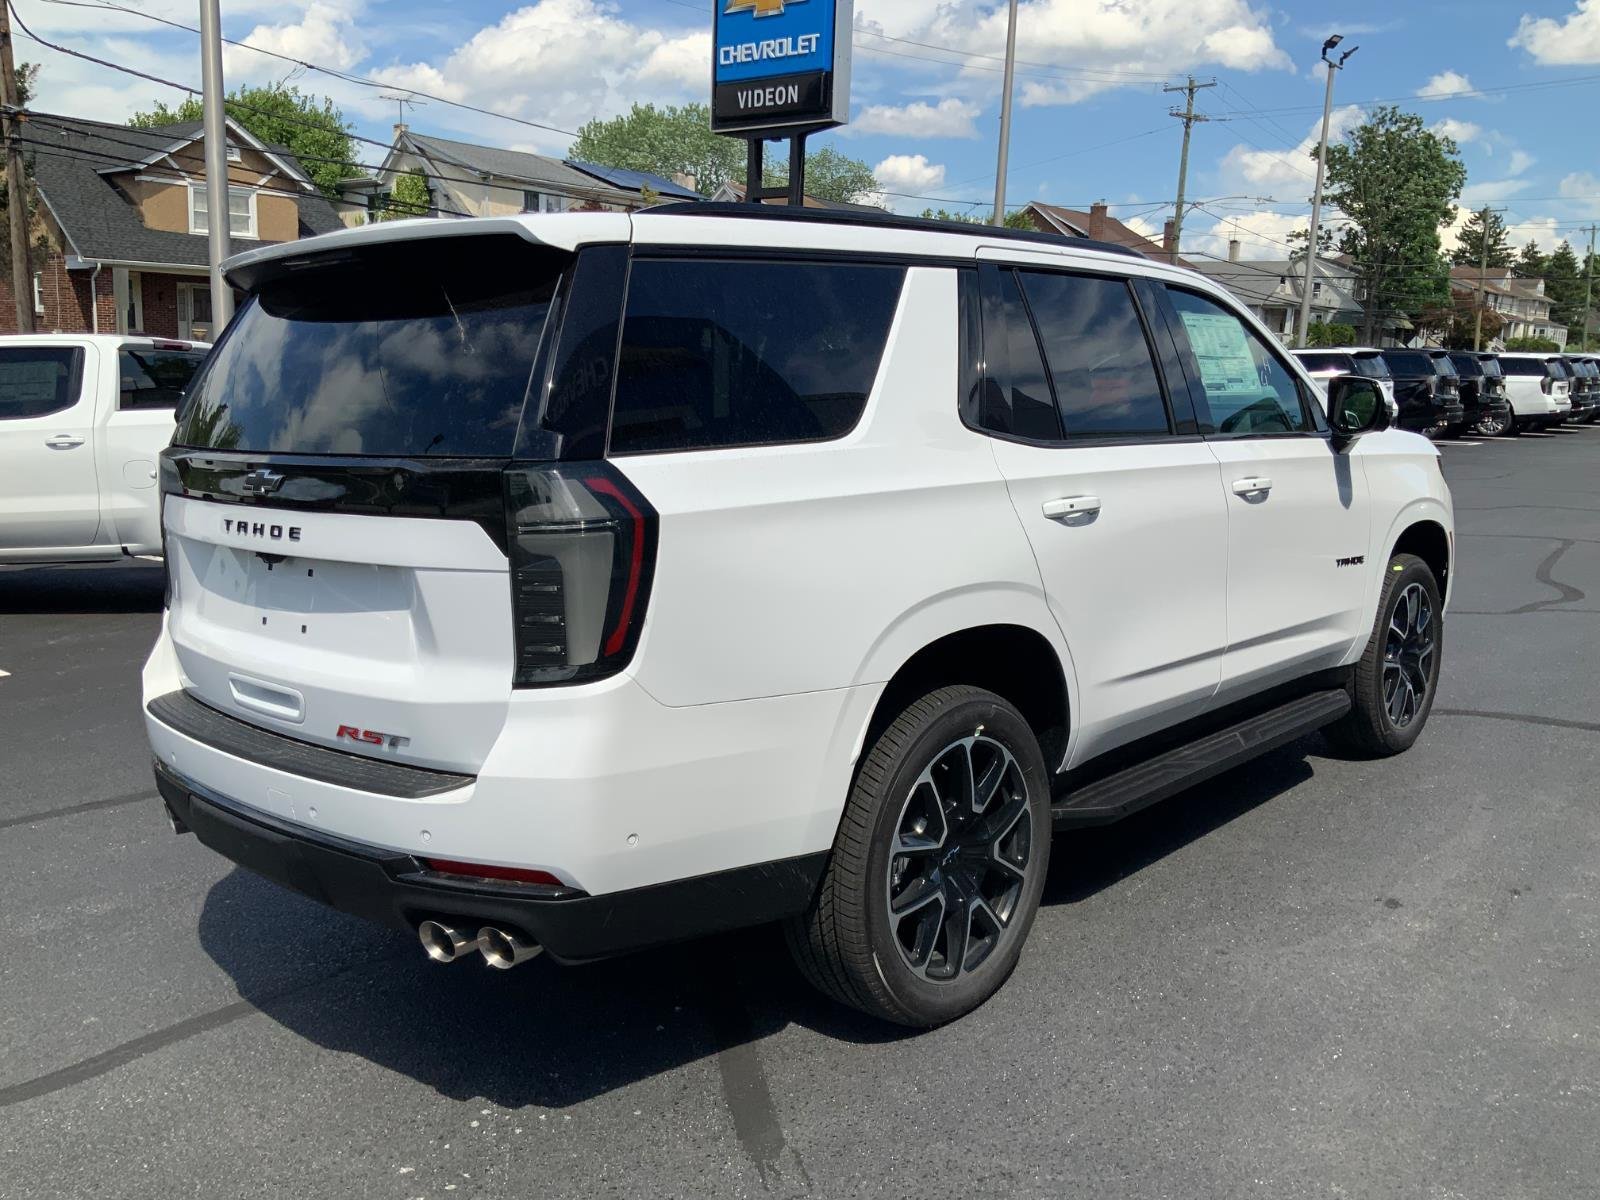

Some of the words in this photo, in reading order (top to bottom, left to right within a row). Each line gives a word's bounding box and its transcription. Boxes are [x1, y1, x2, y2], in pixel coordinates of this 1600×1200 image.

[719, 33, 821, 66] CHEVROLET
[737, 84, 799, 110] VIDEON
[223, 519, 302, 541] TAHOE
[336, 725, 411, 748] RST
